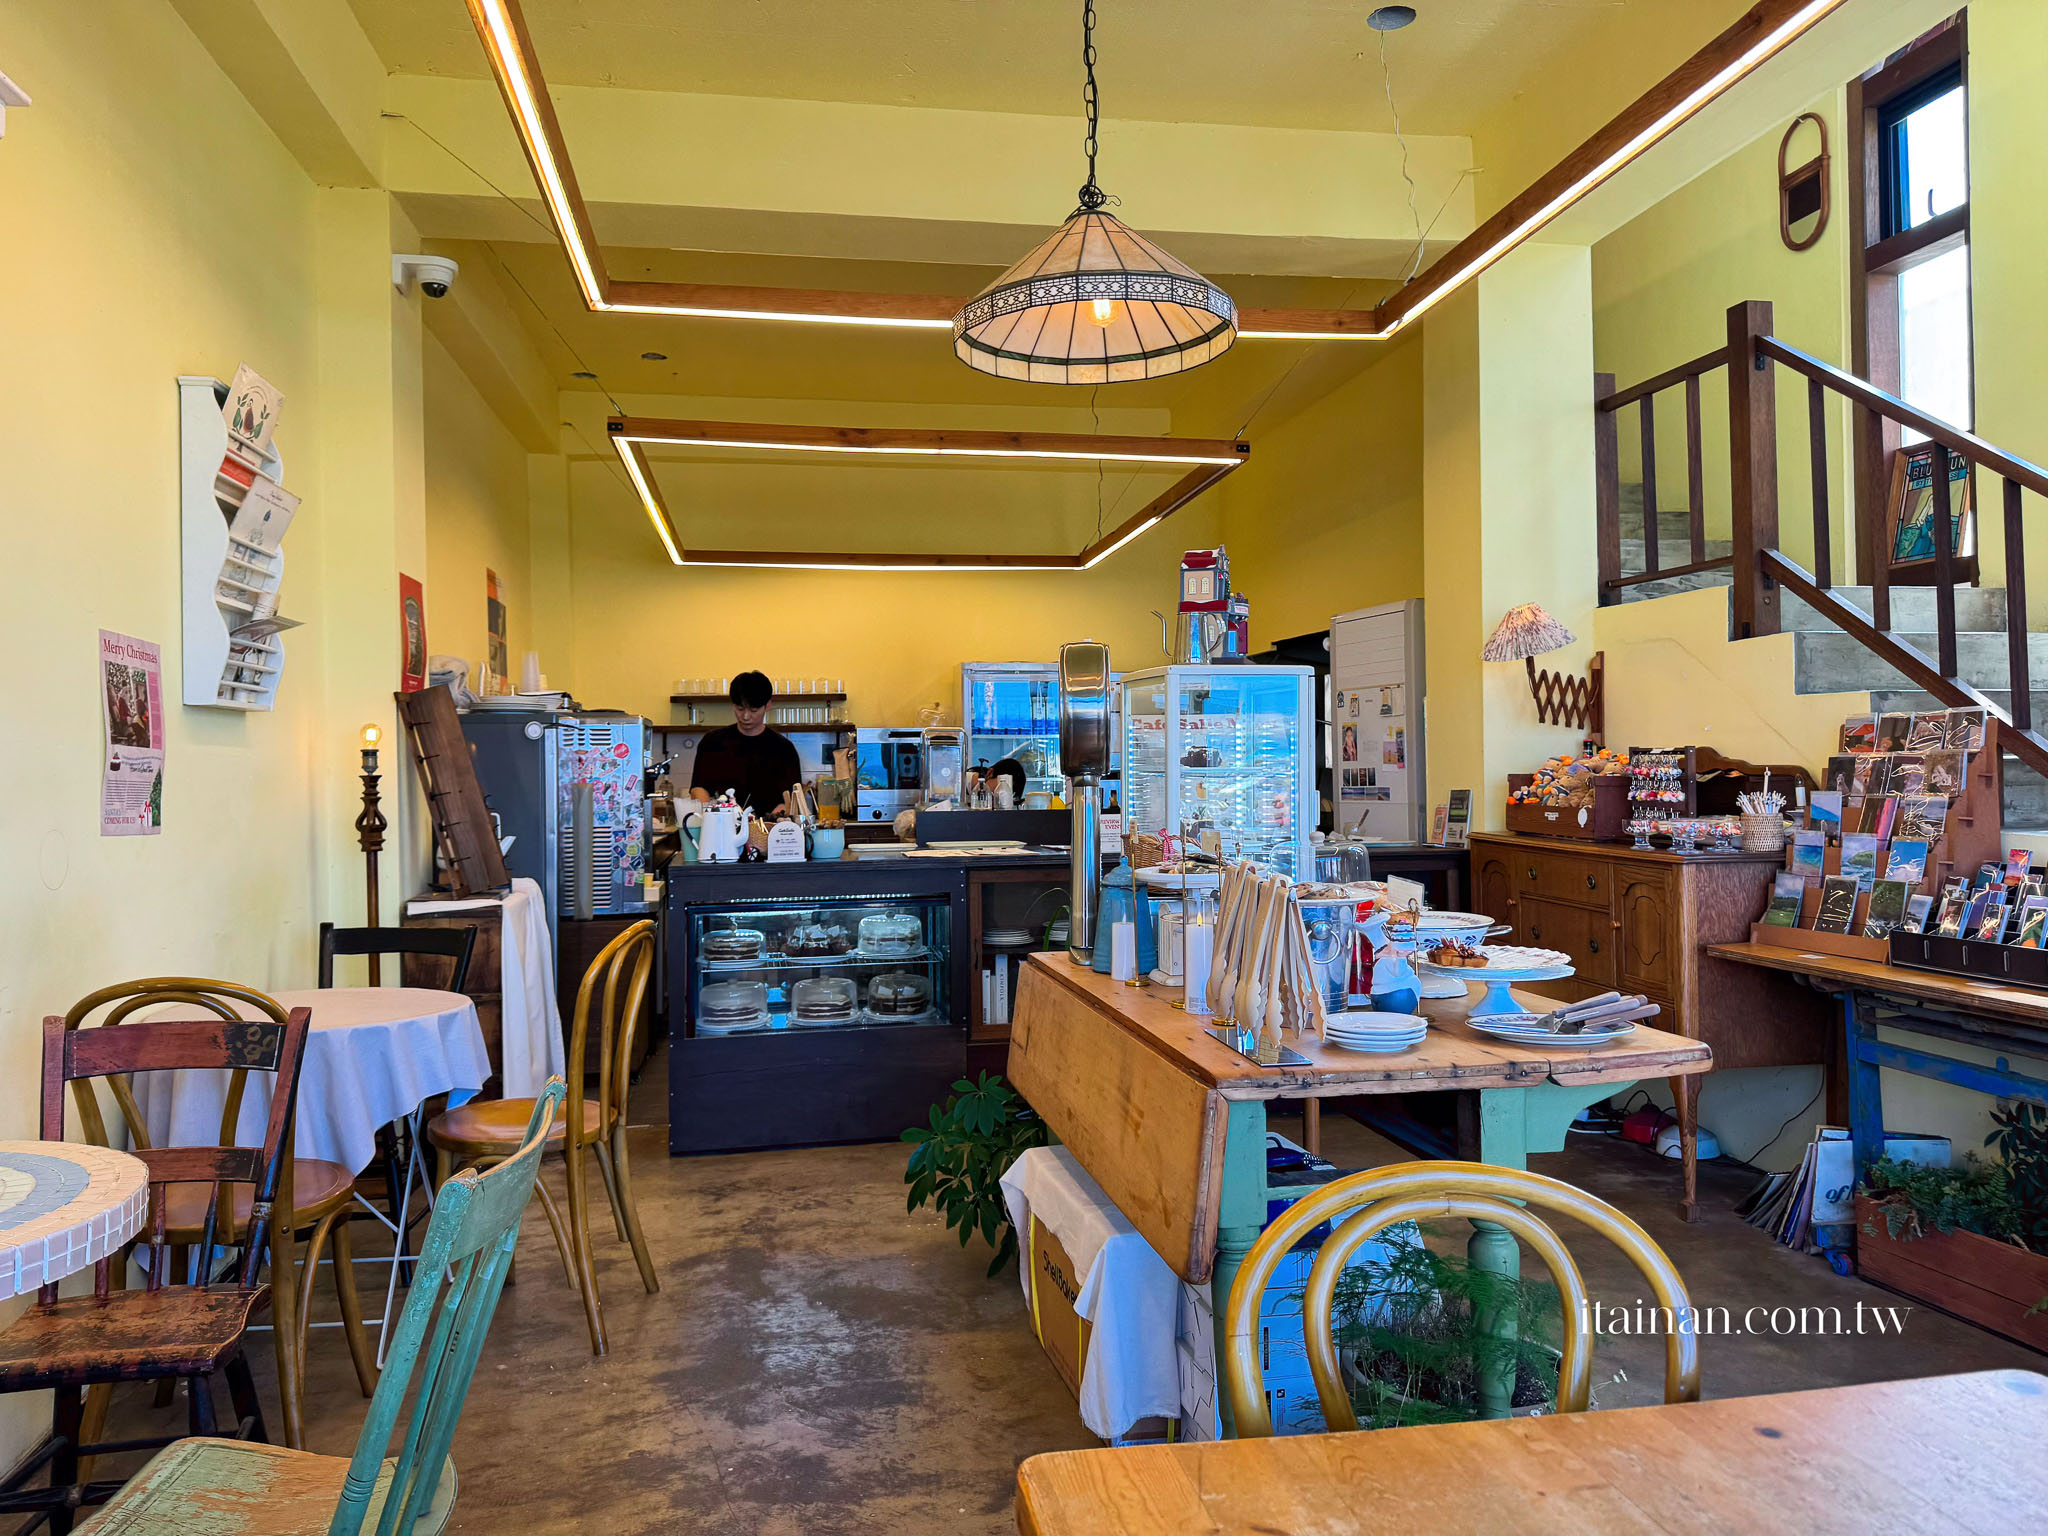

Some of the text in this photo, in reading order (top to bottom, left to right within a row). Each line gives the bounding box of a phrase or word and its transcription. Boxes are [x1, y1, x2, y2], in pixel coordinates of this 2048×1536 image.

[1912, 464, 1932, 480] BLU
[103, 638, 158, 664] Merry Christmas
[1824, 1184, 1850, 1204] of
[1043, 1249, 1078, 1308] ShellBake
